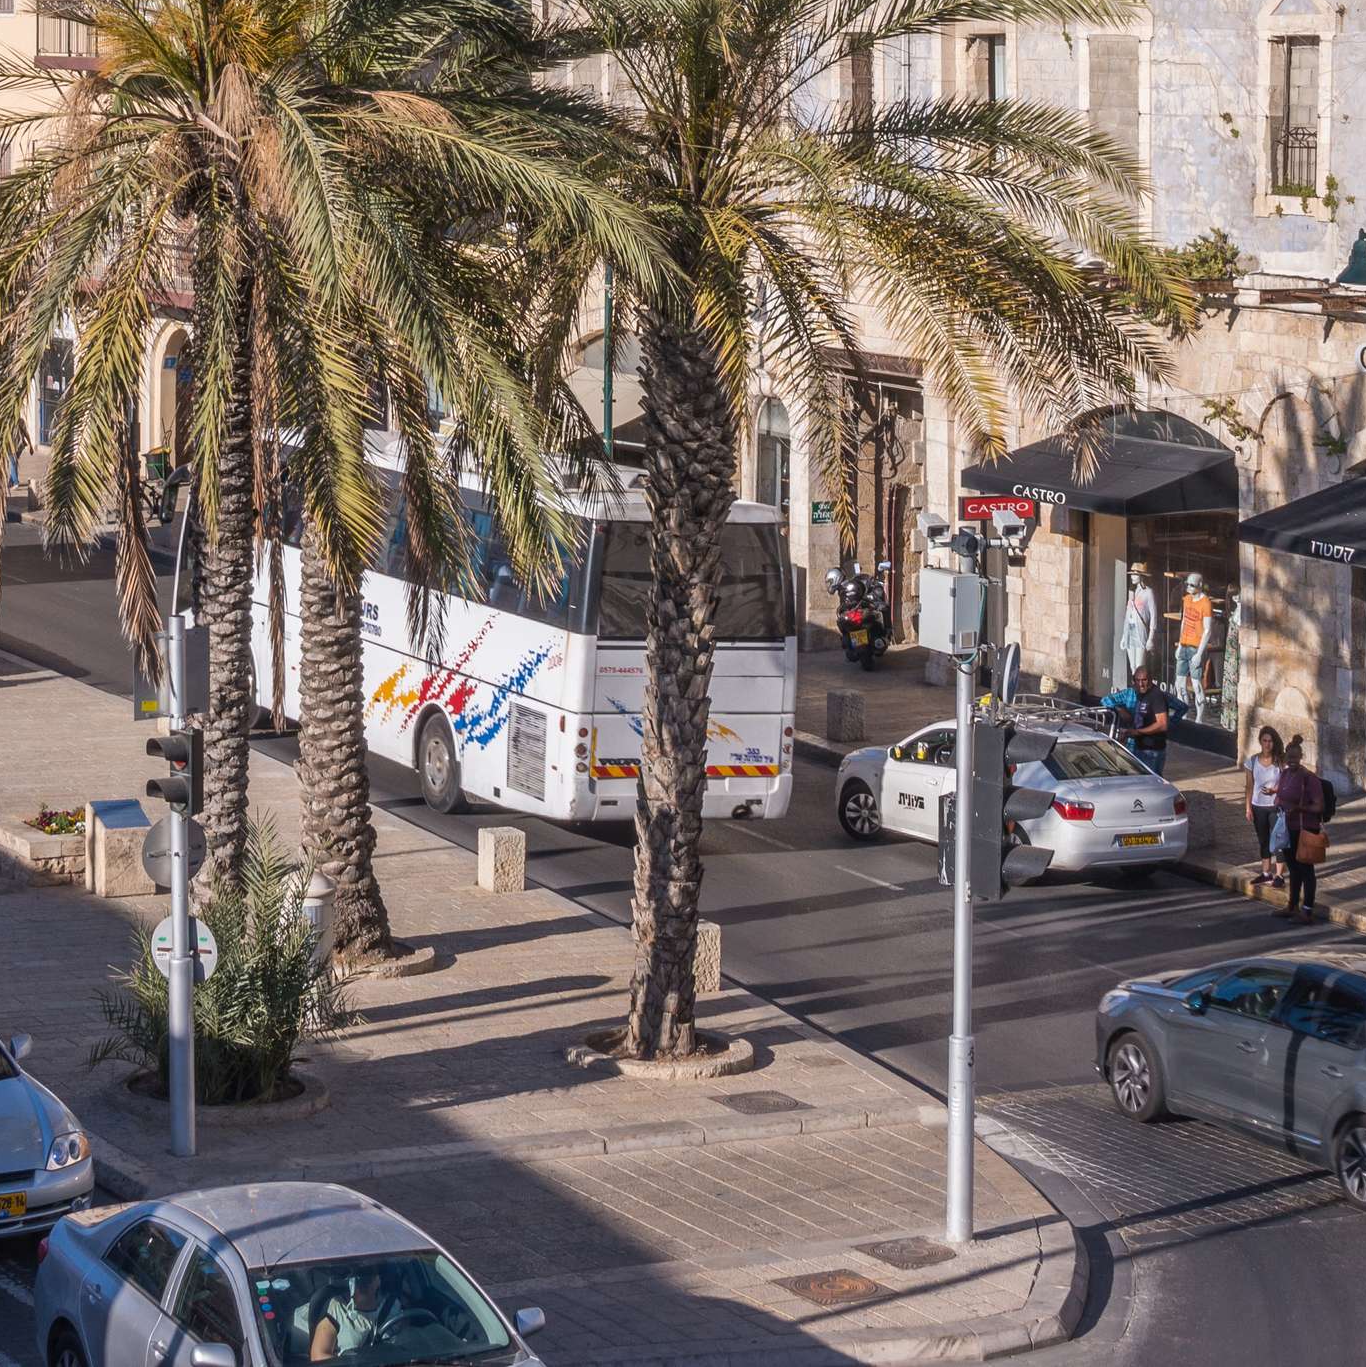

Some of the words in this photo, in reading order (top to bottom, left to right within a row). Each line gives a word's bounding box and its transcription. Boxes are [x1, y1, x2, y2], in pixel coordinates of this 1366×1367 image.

[1012, 484, 1066, 505] CASTRO
[967, 502, 1029, 514] CASTRO
[1310, 540, 1356, 563] קסטרו
